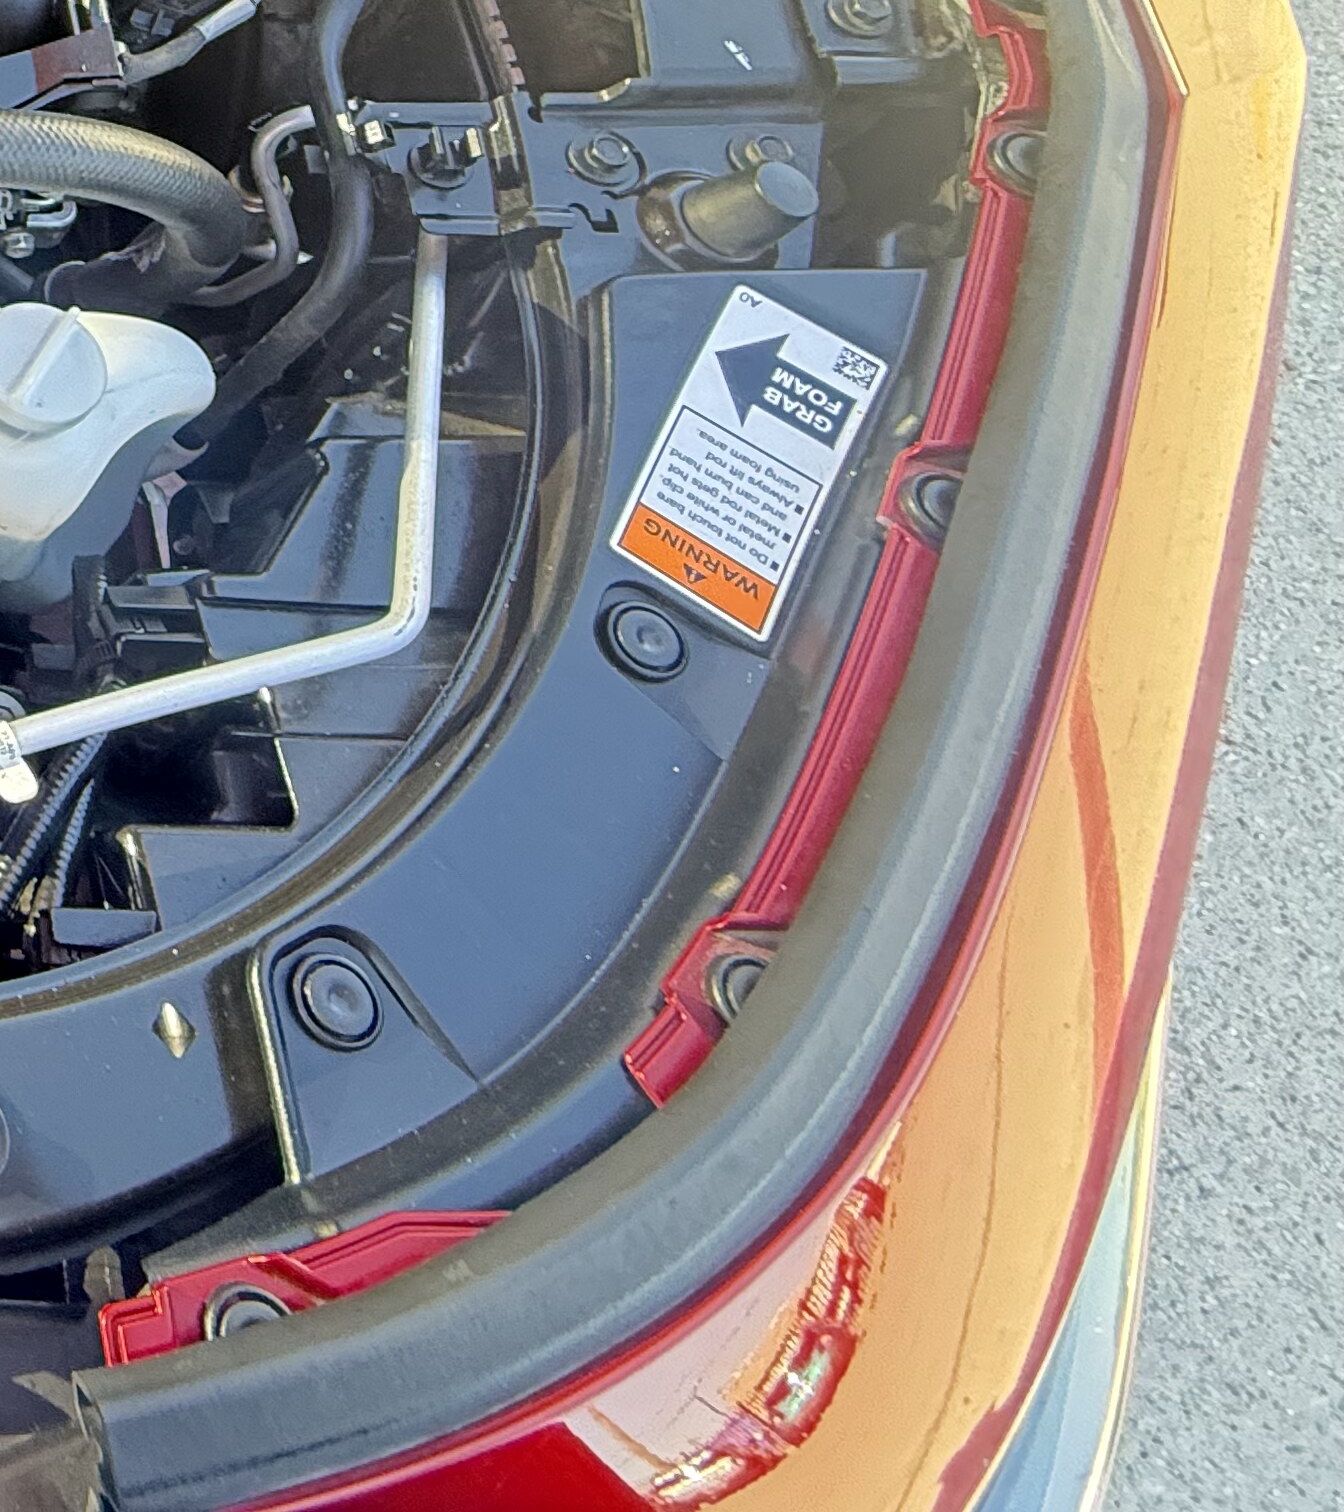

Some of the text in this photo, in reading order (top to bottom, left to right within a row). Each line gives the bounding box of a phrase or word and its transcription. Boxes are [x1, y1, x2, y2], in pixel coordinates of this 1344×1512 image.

[763, 386, 832, 432] GRAB
[771, 367, 842, 415] FOAM
[703, 467, 733, 491] burn
[704, 451, 794, 507] Always lift rod
[729, 448, 762, 473] foam
[764, 466, 800, 493] using
[659, 474, 776, 549] metal or white clip.
[667, 462, 781, 537] Metal rod gets hot
[735, 486, 760, 504] can
[760, 502, 787, 521] and
[656, 490, 769, 565] Do not touch bare
[642, 517, 758, 601] WARNING
